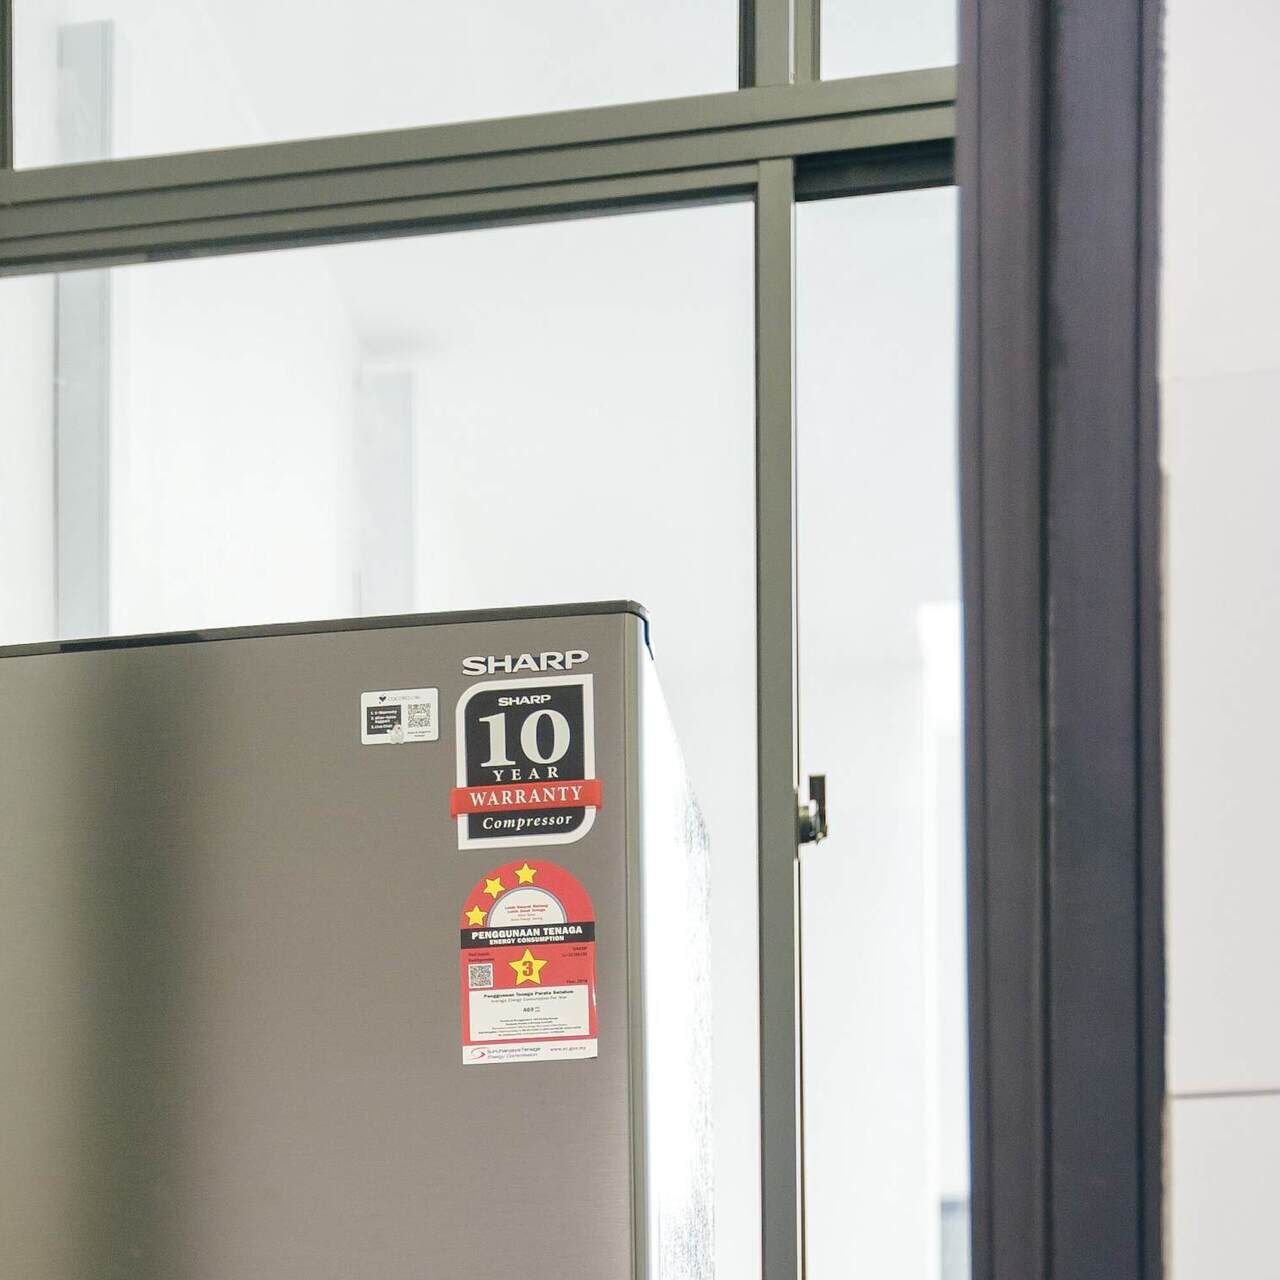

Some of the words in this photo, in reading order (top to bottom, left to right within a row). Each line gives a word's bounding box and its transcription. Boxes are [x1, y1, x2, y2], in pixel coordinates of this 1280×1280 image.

[462, 650, 590, 677] SHARP
[498, 694, 551, 707] SHARP
[478, 709, 571, 768] 10
[493, 766, 559, 782] YEAR
[470, 785, 583, 807] WARRANTY
[482, 814, 573, 832] Compressor
[471, 928, 541, 940] PENGGUNAAN
[543, 925, 583, 935] TENAGA
[489, 937, 515, 945] ENERGY
[517, 934, 565, 944] CONSUMPTION
[522, 960, 534, 977] 3
